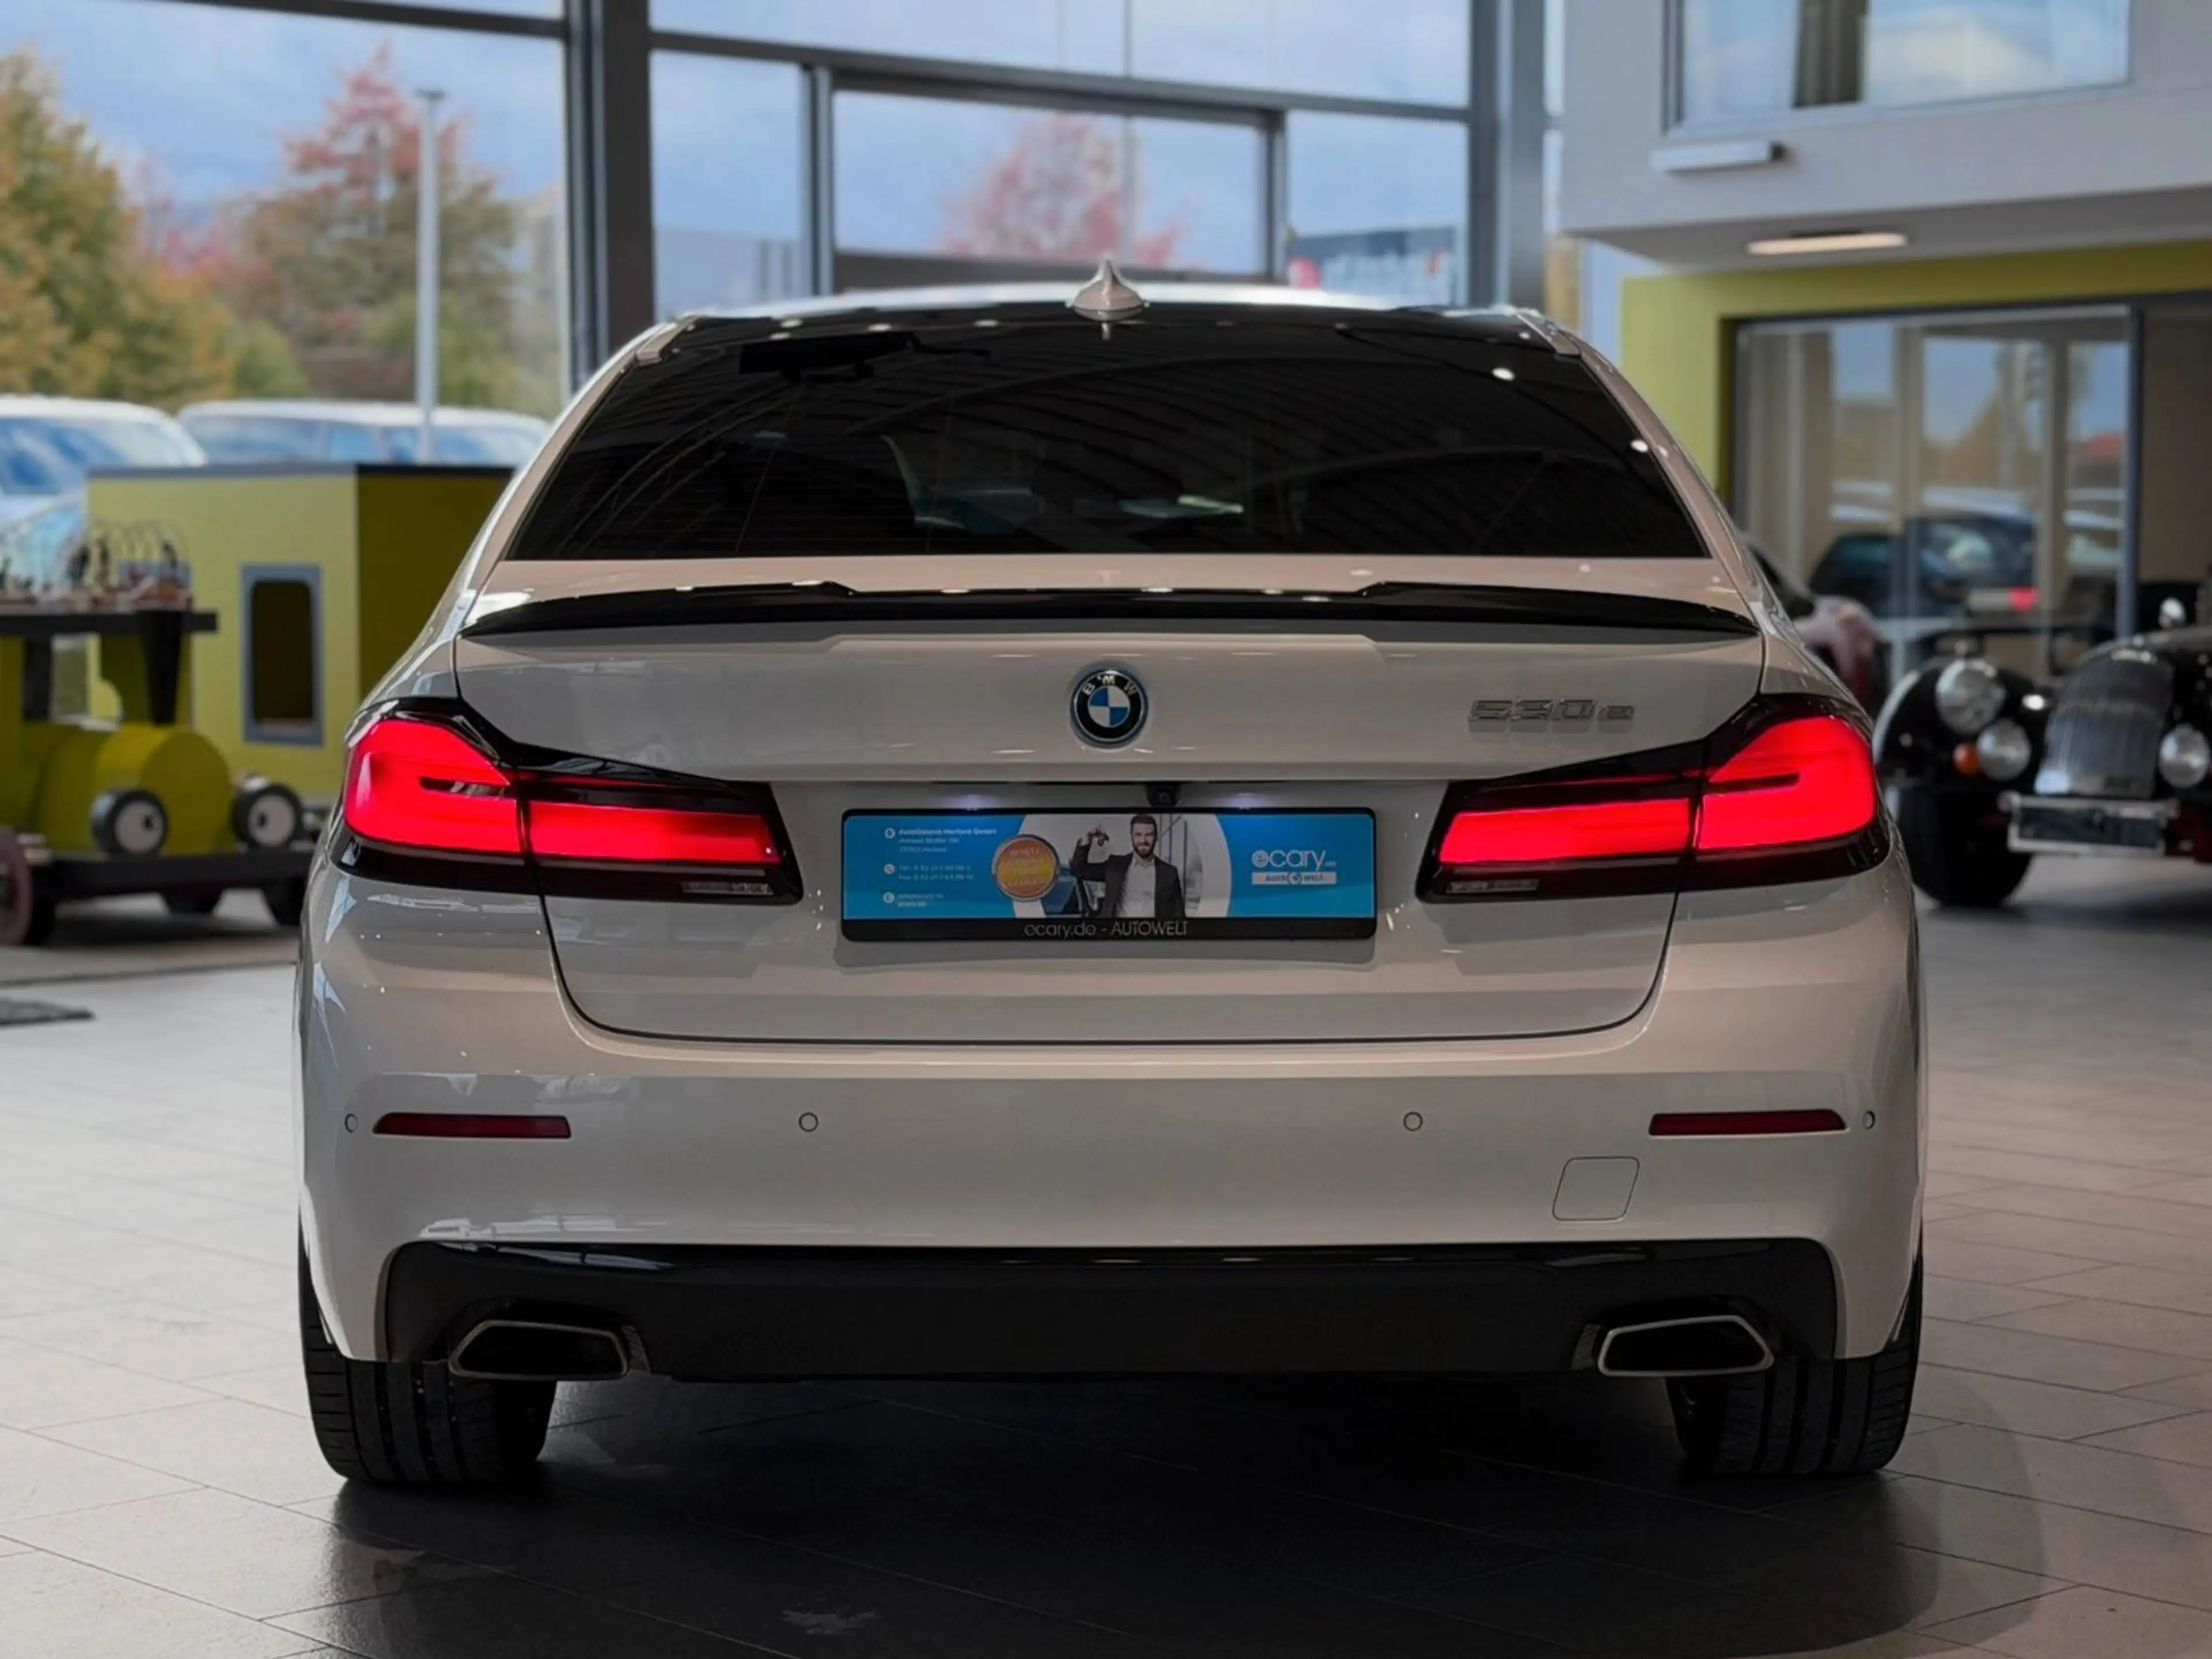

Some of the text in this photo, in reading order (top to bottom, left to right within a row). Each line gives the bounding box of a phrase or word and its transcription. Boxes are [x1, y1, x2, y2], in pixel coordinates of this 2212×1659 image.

[1082, 675, 1138, 695] BMW
[1024, 923, 1096, 938] ecary.de
[1111, 922, 1188, 936] AUTOWELT
